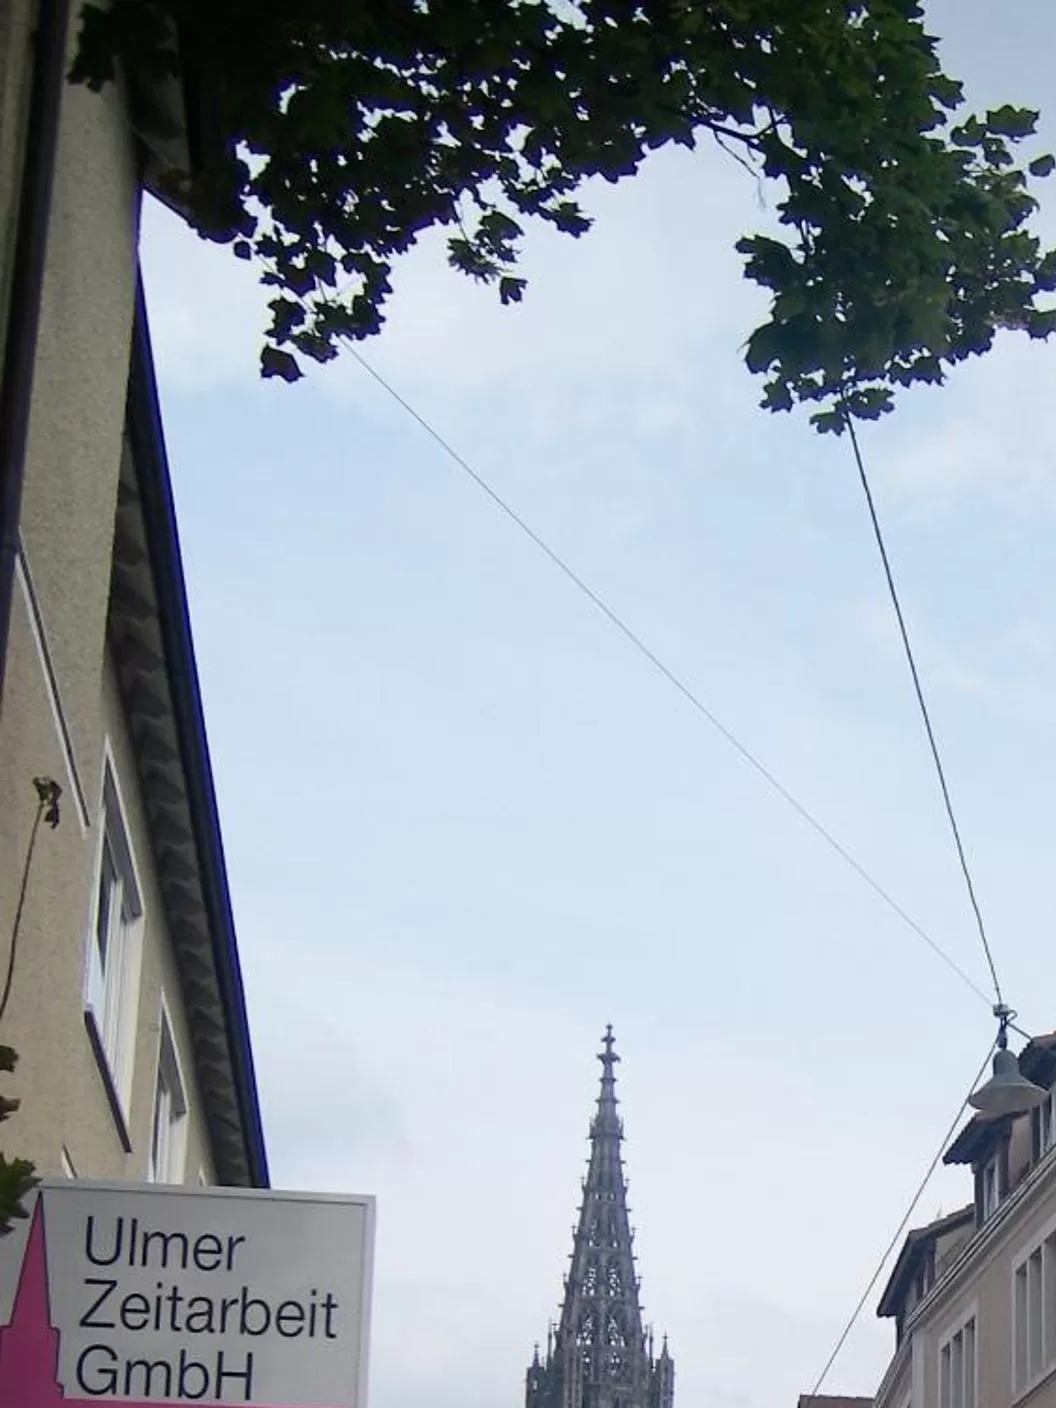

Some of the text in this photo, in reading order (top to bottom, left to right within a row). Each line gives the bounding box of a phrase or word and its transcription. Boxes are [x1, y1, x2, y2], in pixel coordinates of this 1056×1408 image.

[84, 1215, 246, 1271] Ulmer
[79, 1278, 339, 1339] Zeitarbeit
[76, 1344, 253, 1400] GmbH
